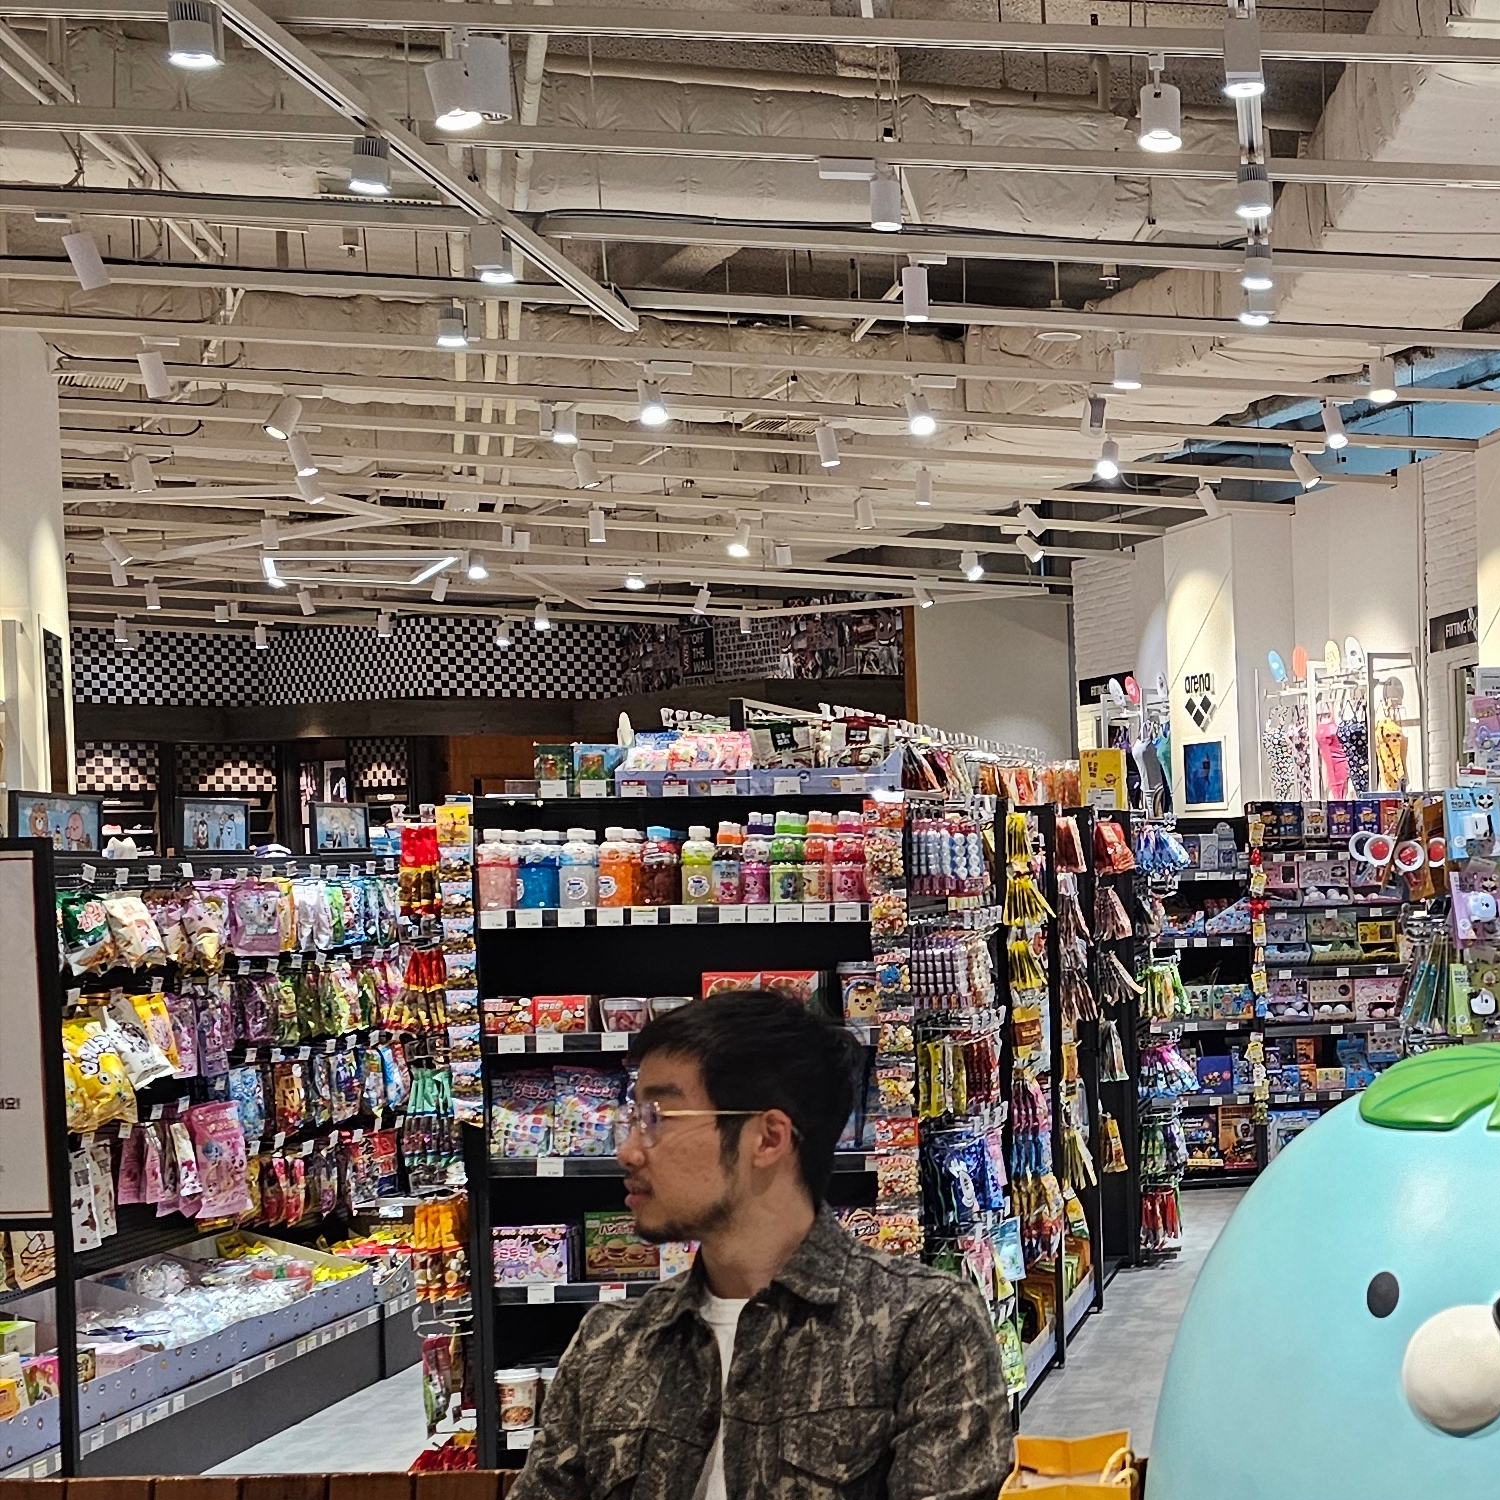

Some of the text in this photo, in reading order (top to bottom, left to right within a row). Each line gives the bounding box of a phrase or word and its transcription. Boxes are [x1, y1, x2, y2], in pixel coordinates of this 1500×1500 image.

[1445, 620, 1467, 639] FITTING
[692, 632, 704, 644] OFF
[693, 647, 705, 659] THE
[693, 659, 714, 673] WALL
[1185, 673, 1210, 694] arena
